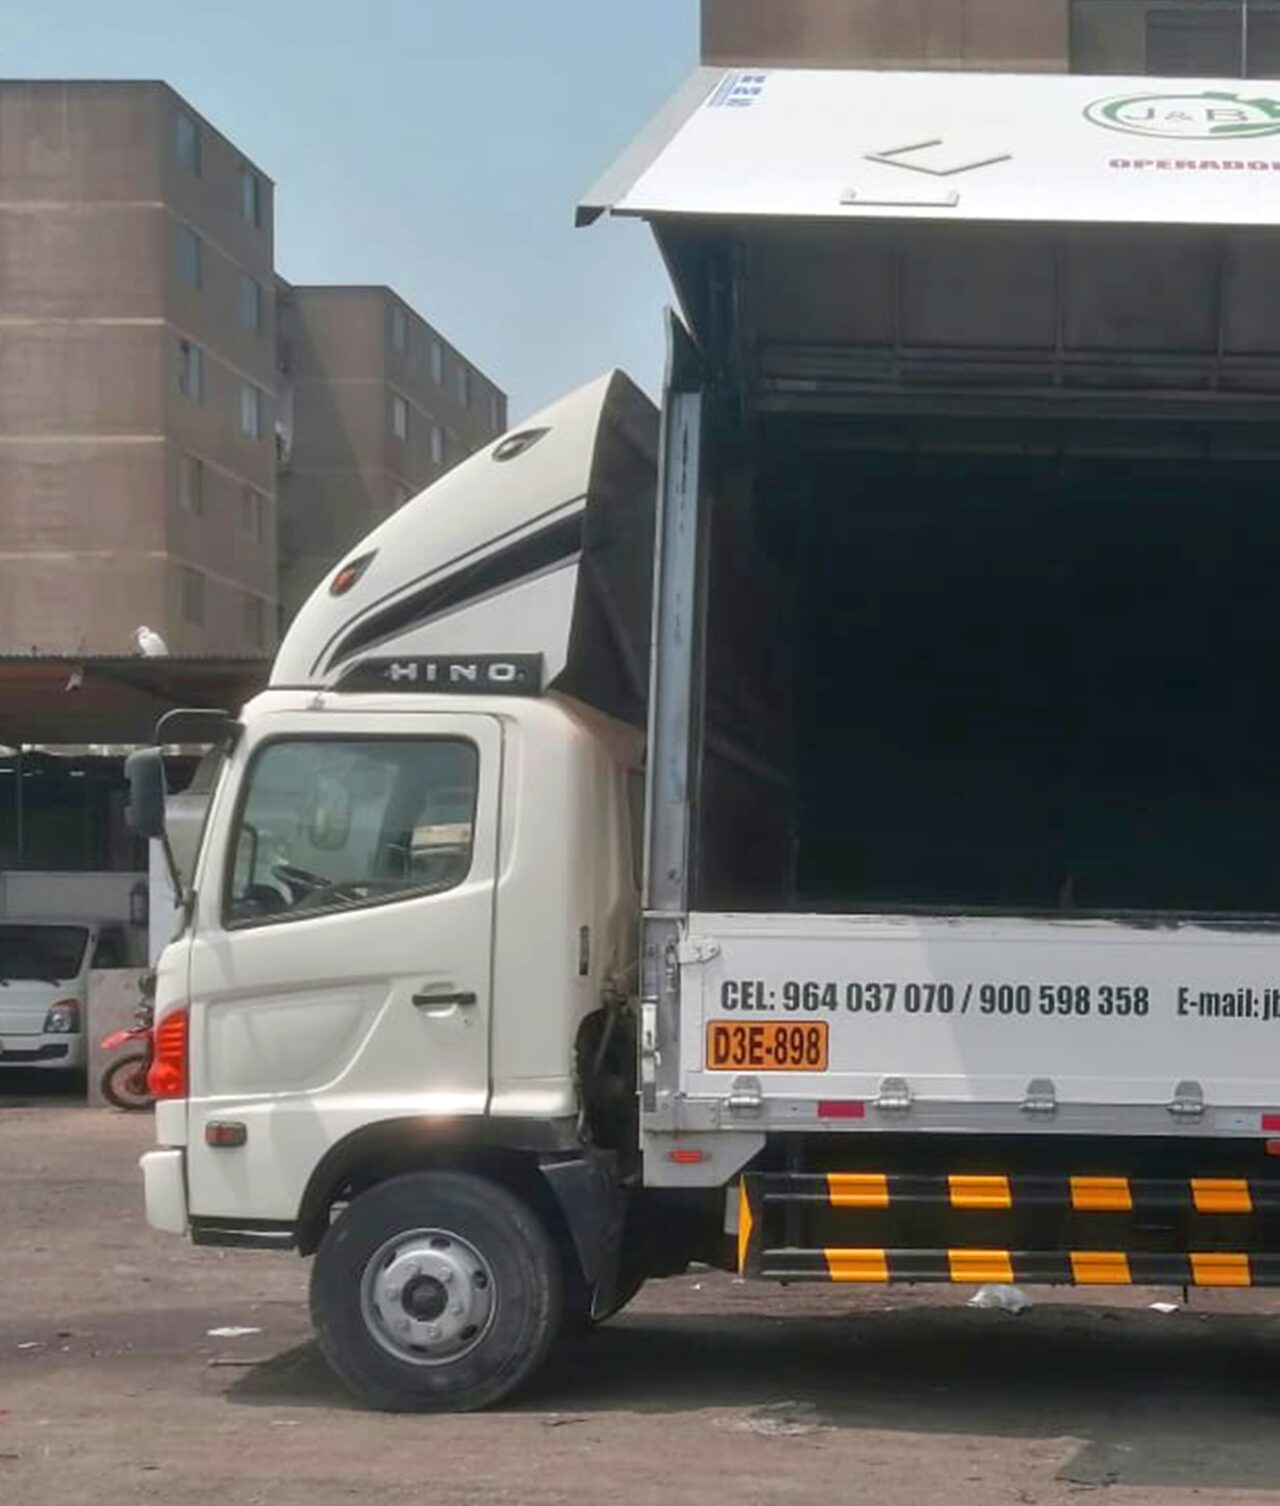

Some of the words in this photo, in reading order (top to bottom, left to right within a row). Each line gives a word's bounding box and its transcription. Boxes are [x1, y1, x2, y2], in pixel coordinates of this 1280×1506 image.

[389, 662, 516, 682] HINO
[721, 981, 775, 1012] CEL:
[783, 982, 838, 1012] 964
[846, 983, 897, 1013] 037
[904, 984, 953, 1013] 070
[961, 985, 972, 1013] /
[979, 985, 1030, 1014] 900
[1039, 986, 1090, 1015] 598
[1098, 987, 1149, 1016] 358
[1177, 987, 1259, 1017] E-mail:
[714, 1027, 821, 1066] D3E-898
